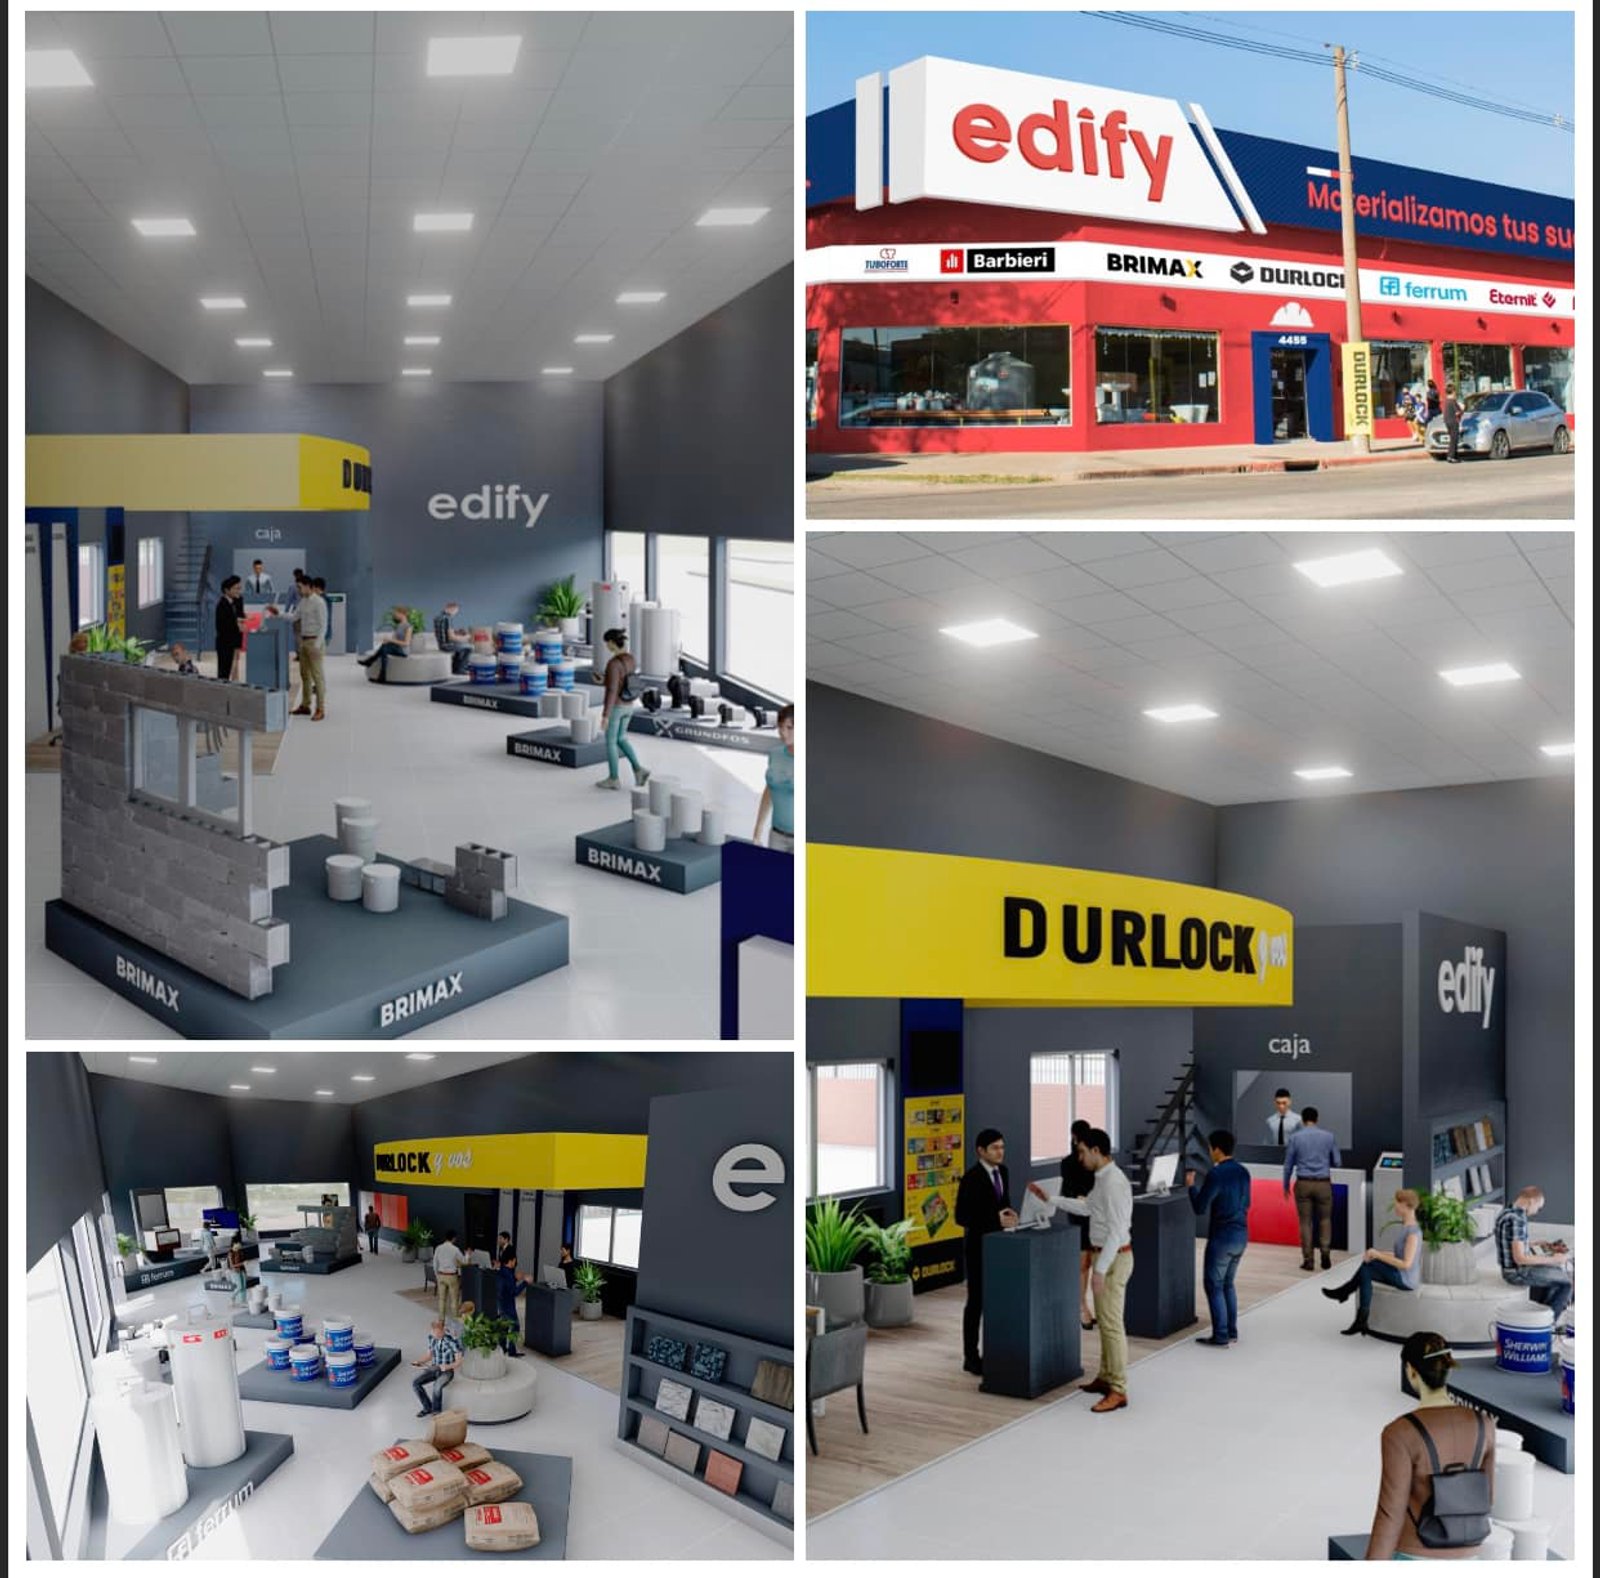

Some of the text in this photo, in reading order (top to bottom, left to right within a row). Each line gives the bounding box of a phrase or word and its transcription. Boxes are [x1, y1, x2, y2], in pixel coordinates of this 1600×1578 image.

[953, 99, 1173, 202] edify
[1307, 180, 1575, 249] Maerializamos tus su
[973, 251, 1048, 268] Barbieri
[1107, 253, 1203, 278] BRIMAX
[1404, 282, 1467, 301] ferrum
[1489, 288, 1537, 306] Eternit
[1278, 335, 1307, 345] 4455
[1353, 351, 1369, 426] DURLOCK
[427, 484, 550, 528] edify
[255, 528, 282, 543] caja
[514, 742, 561, 761] BRIMAX
[587, 847, 662, 883] BRIMAX
[1003, 896, 1257, 975] DURLOCK
[115, 955, 181, 1012] BRIMAX
[380, 972, 464, 1028] BRIMAX
[1437, 946, 1495, 1029] edify
[1268, 1033, 1311, 1060] caja
